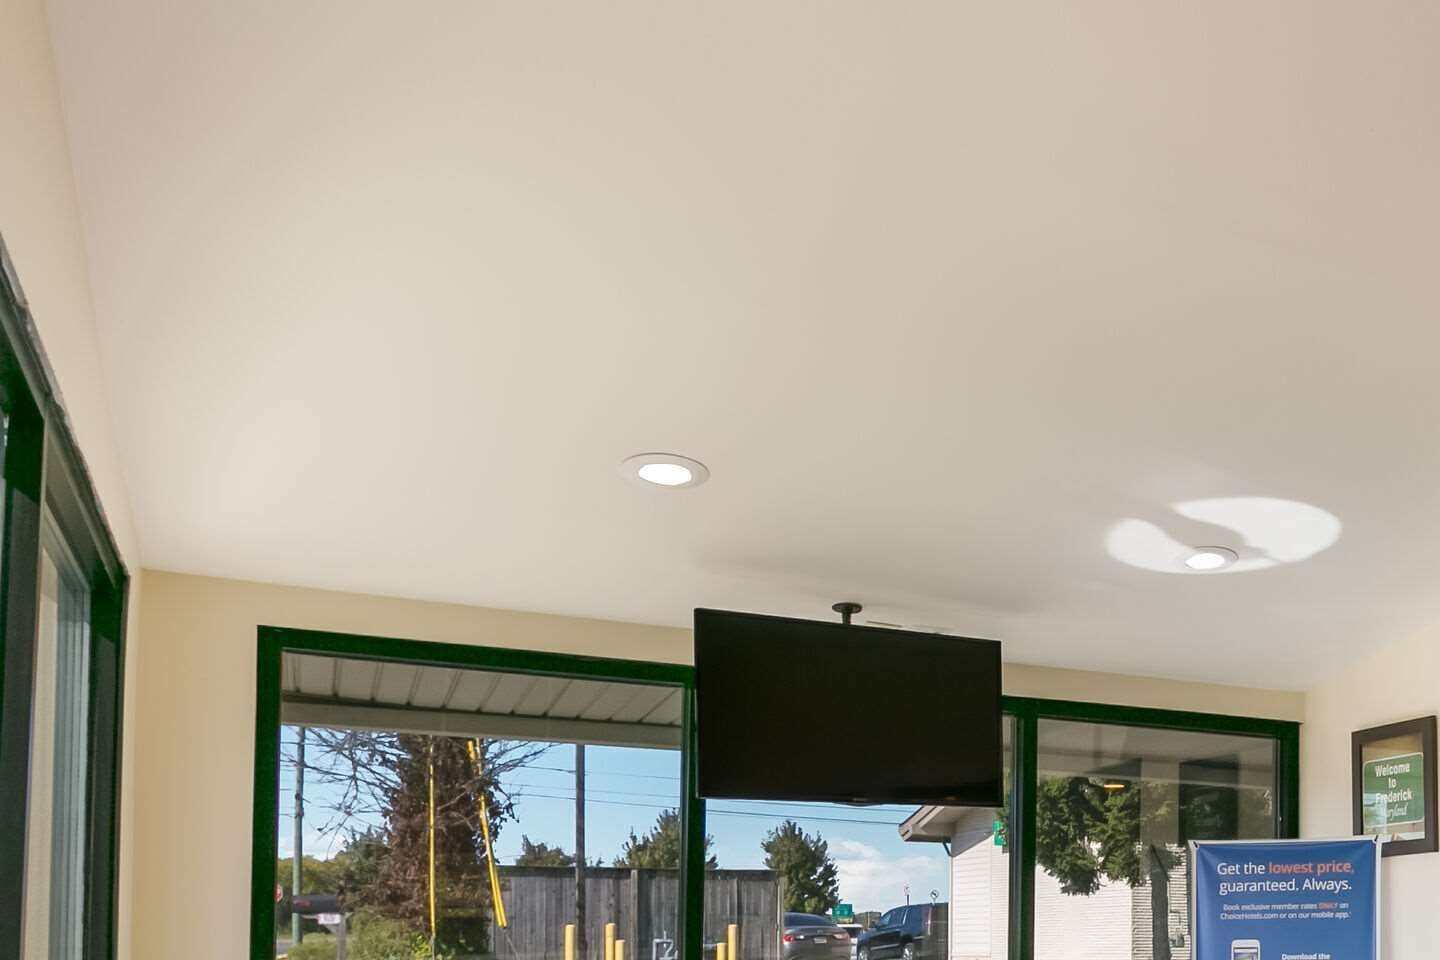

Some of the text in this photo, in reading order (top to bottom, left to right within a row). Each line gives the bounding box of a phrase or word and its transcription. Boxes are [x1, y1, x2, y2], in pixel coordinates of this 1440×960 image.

[1375, 762, 1410, 777] Welcome
[1388, 777, 1397, 788] to
[1375, 788, 1413, 804] Frederick
[1216, 862, 1240, 875] Get
[1243, 862, 1265, 875] the
[1268, 861, 1313, 874] lowest
[1219, 877, 1352, 895] guaranteed. Always.
[1318, 953, 1331, 960] the
